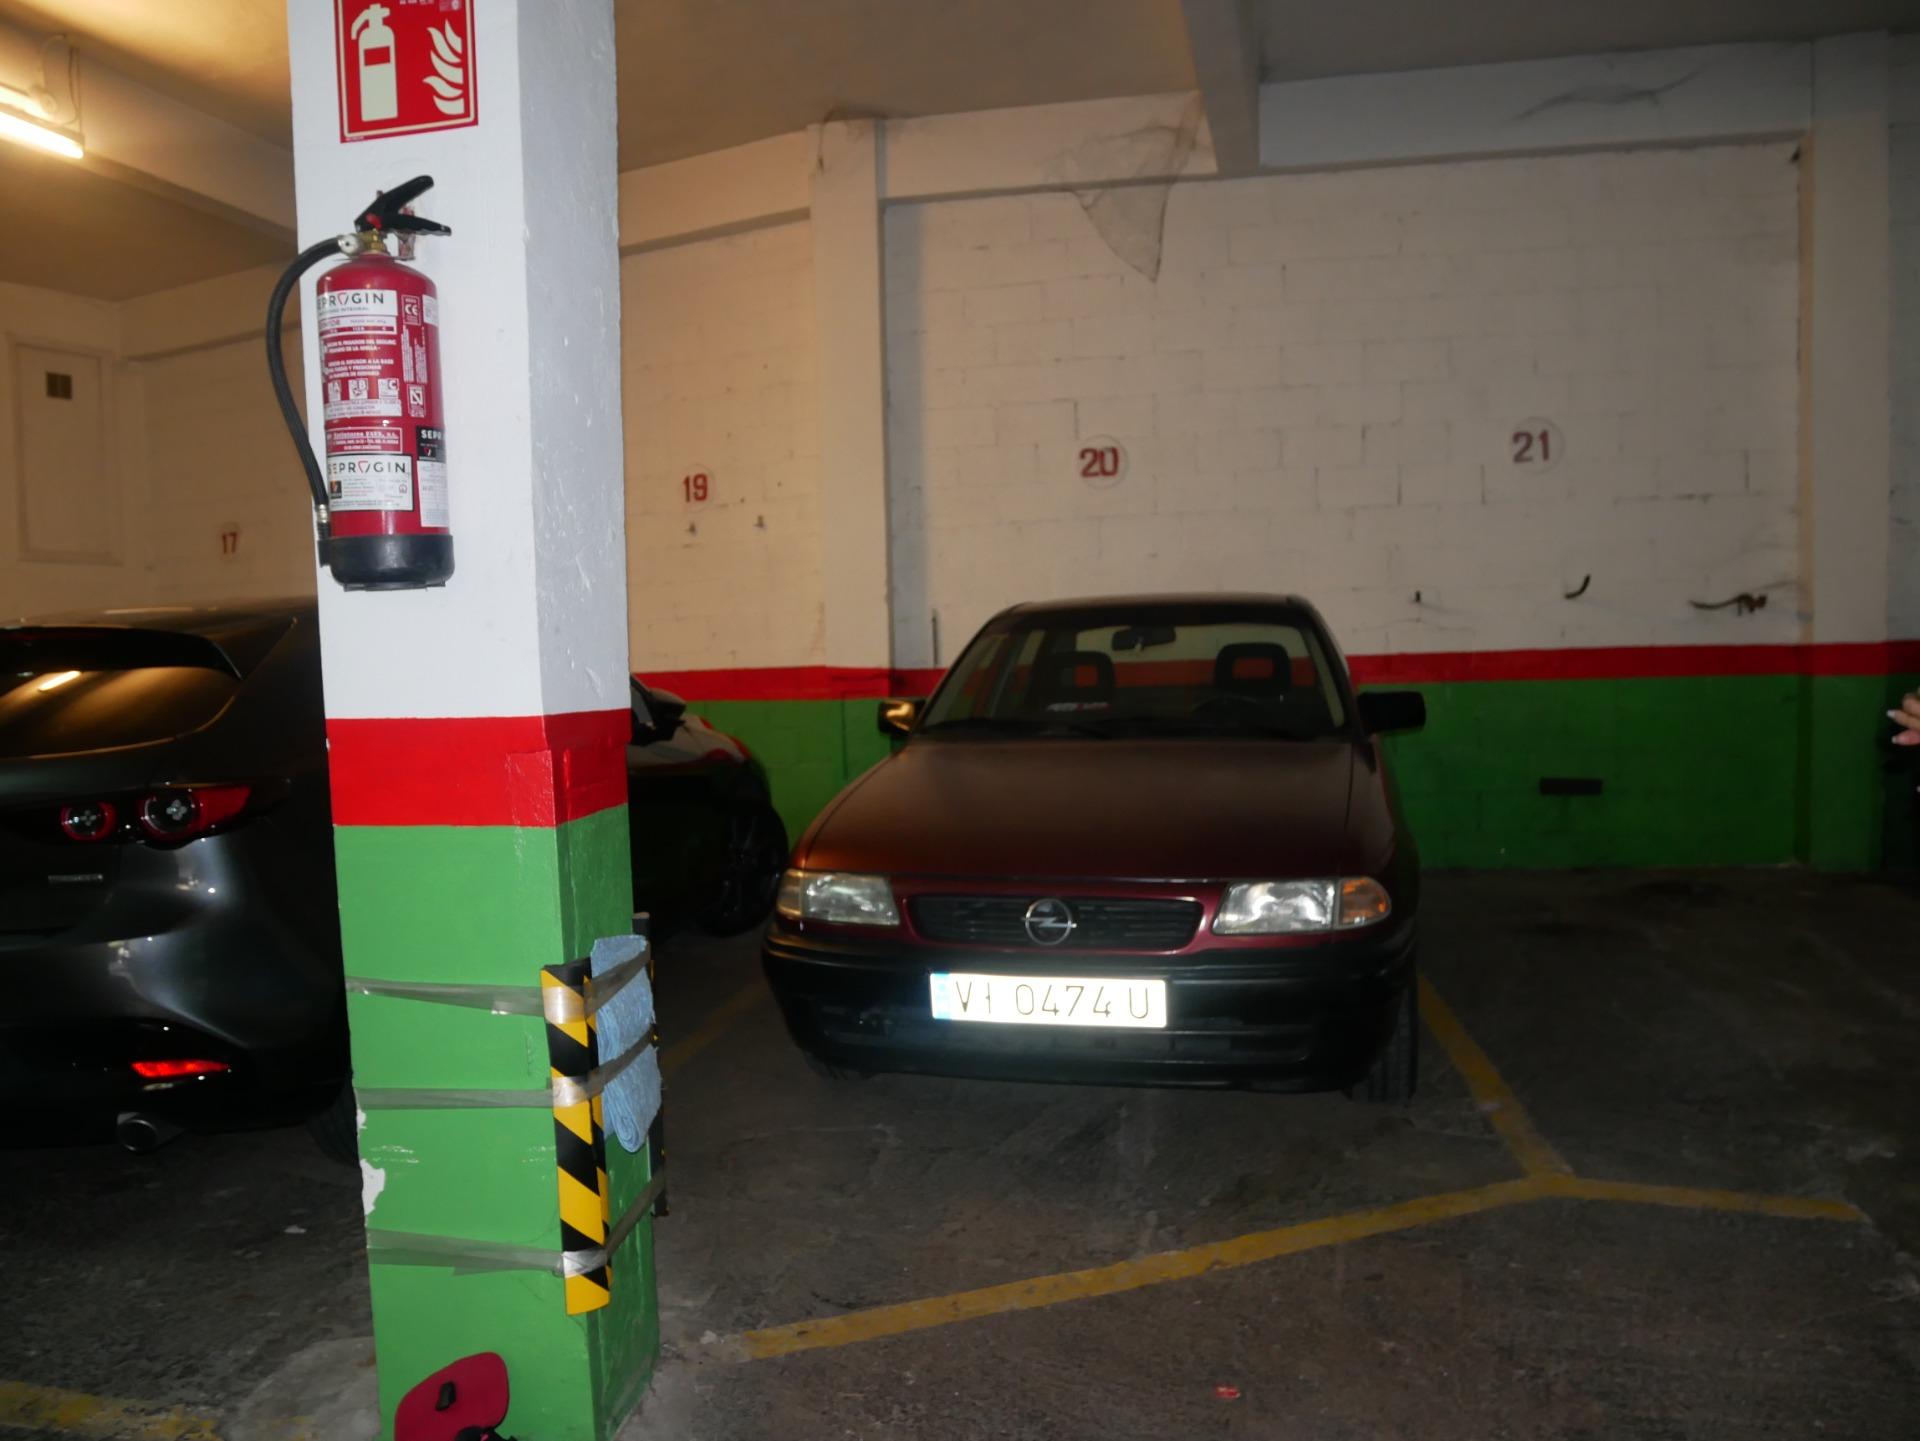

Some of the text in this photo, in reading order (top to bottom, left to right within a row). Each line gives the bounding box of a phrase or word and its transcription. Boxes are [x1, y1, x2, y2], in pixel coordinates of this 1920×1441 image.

[405, 303, 418, 316] CE
[388, 379, 398, 390] C
[1512, 429, 1549, 463] 21
[1079, 446, 1119, 478] 20
[682, 473, 708, 503] 19
[221, 531, 238, 555] 17
[955, 980, 1150, 1019] VI 0474 U
